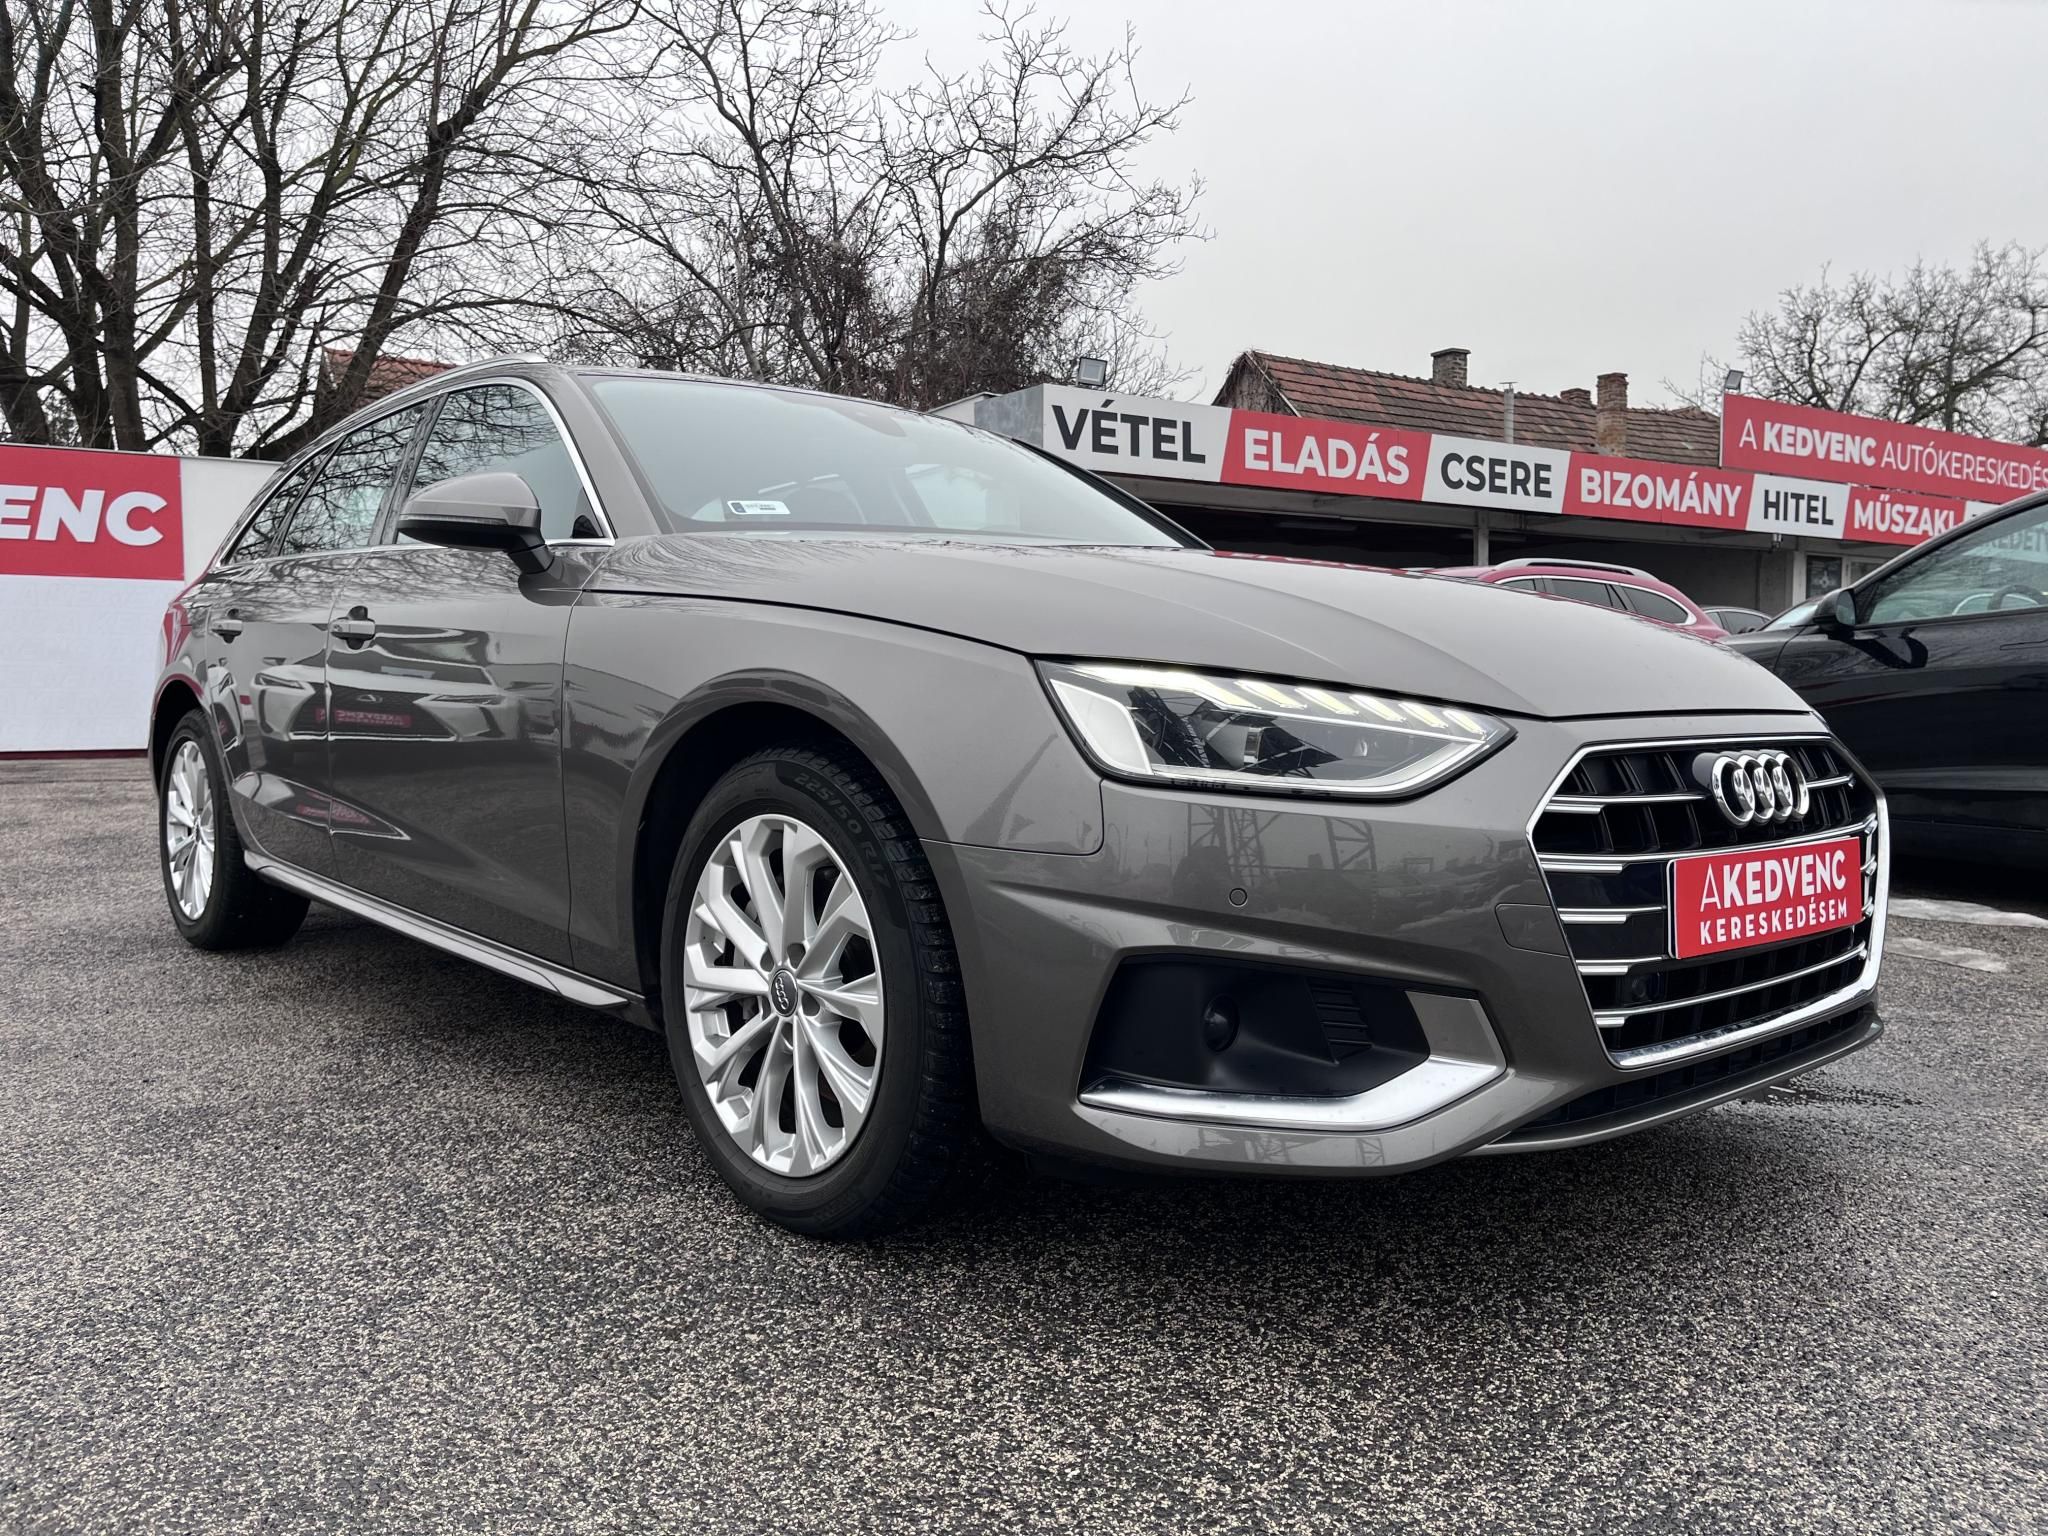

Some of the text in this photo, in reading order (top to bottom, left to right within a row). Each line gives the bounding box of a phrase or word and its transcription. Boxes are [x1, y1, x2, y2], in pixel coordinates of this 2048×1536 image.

[1739, 418, 1757, 450] A
[1763, 421, 1877, 467] KEDVENC
[1051, 399, 1206, 464] VÉTEL
[1244, 432, 1410, 485] ELADÁS
[1440, 452, 1553, 499] CSERE
[1580, 467, 1742, 517] BIZOMÁNY
[1763, 489, 1834, 526] HITEL
[1853, 494, 1957, 537] MŰSZAKI
[1700, 897, 1848, 946] KERESKEDÉSEM
